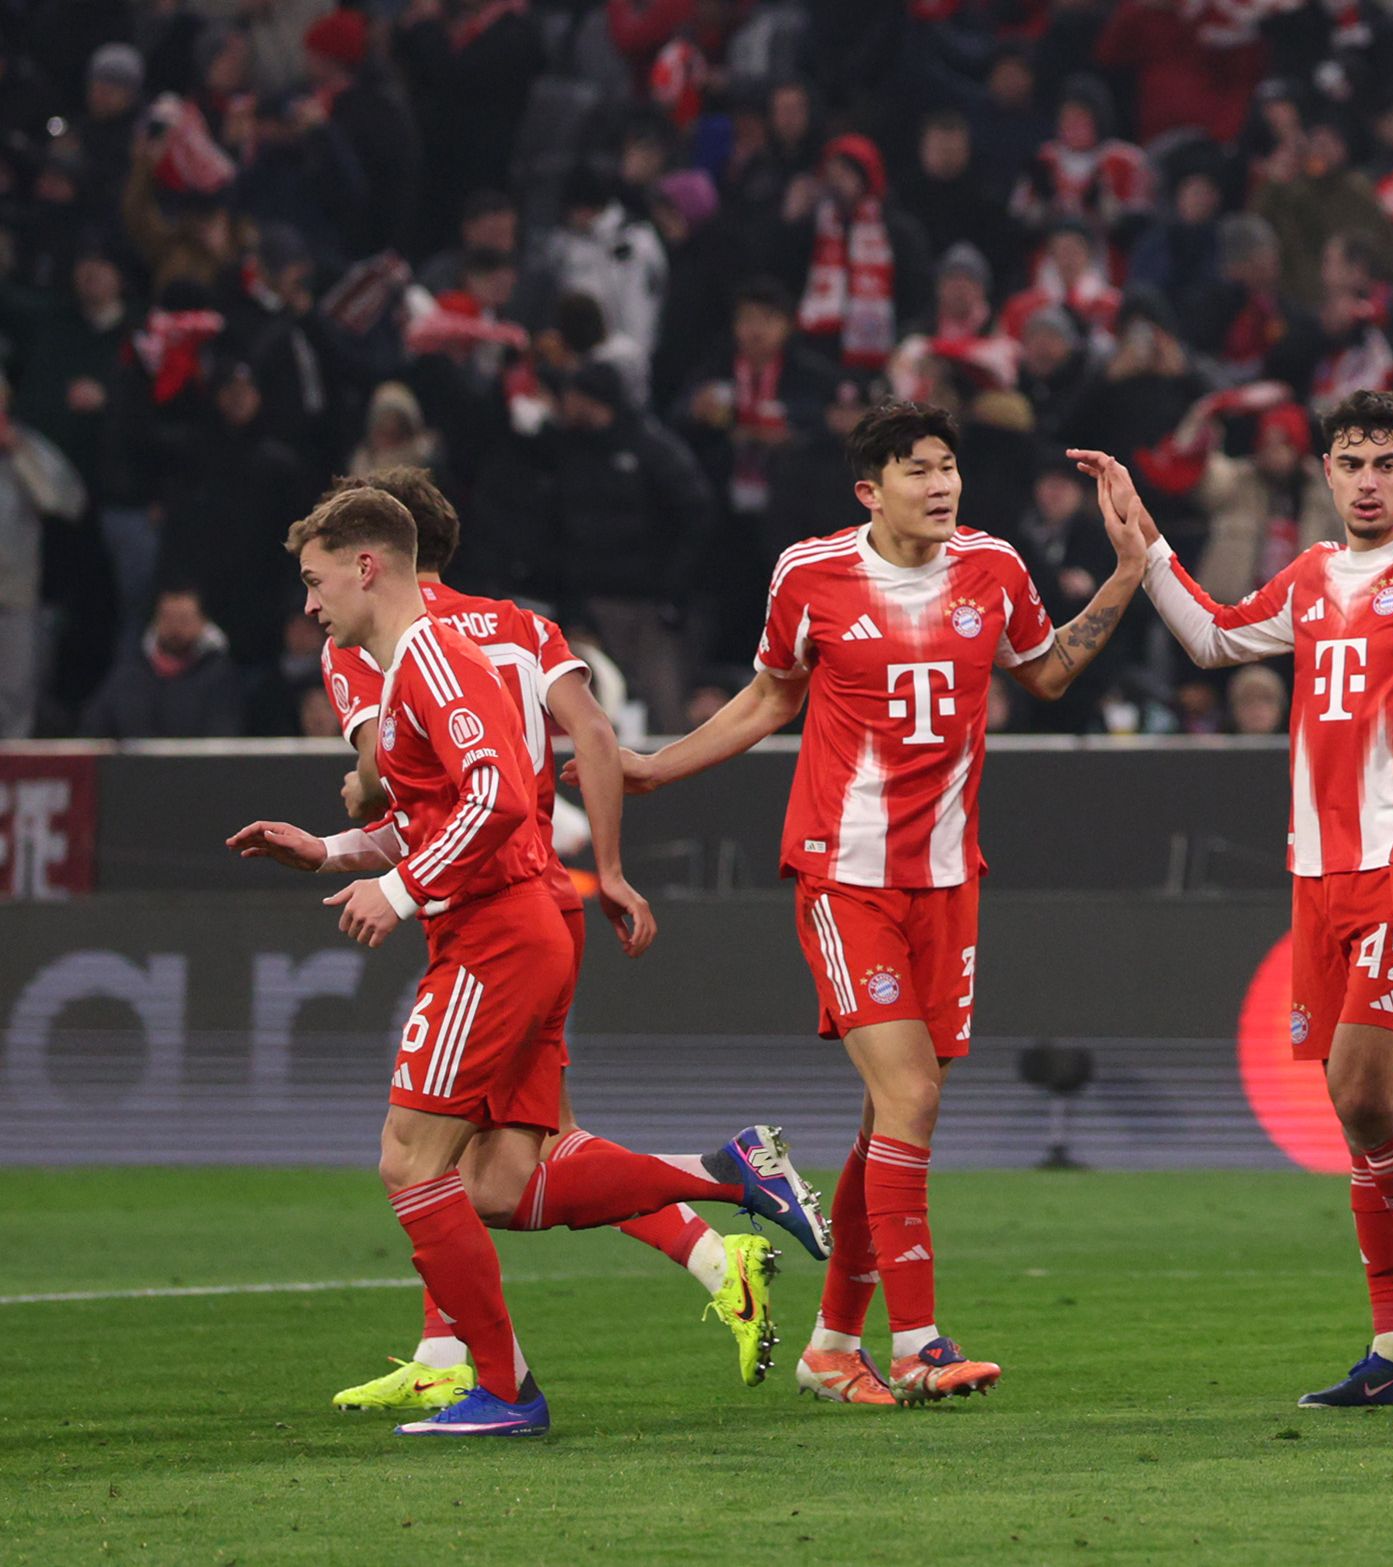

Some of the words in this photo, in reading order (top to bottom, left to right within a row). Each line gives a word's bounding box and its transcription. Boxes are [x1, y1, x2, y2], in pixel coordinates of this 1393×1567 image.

[887, 661, 956, 745] T
[1314, 638, 1367, 722] T
[402, 992, 434, 1053] 6
